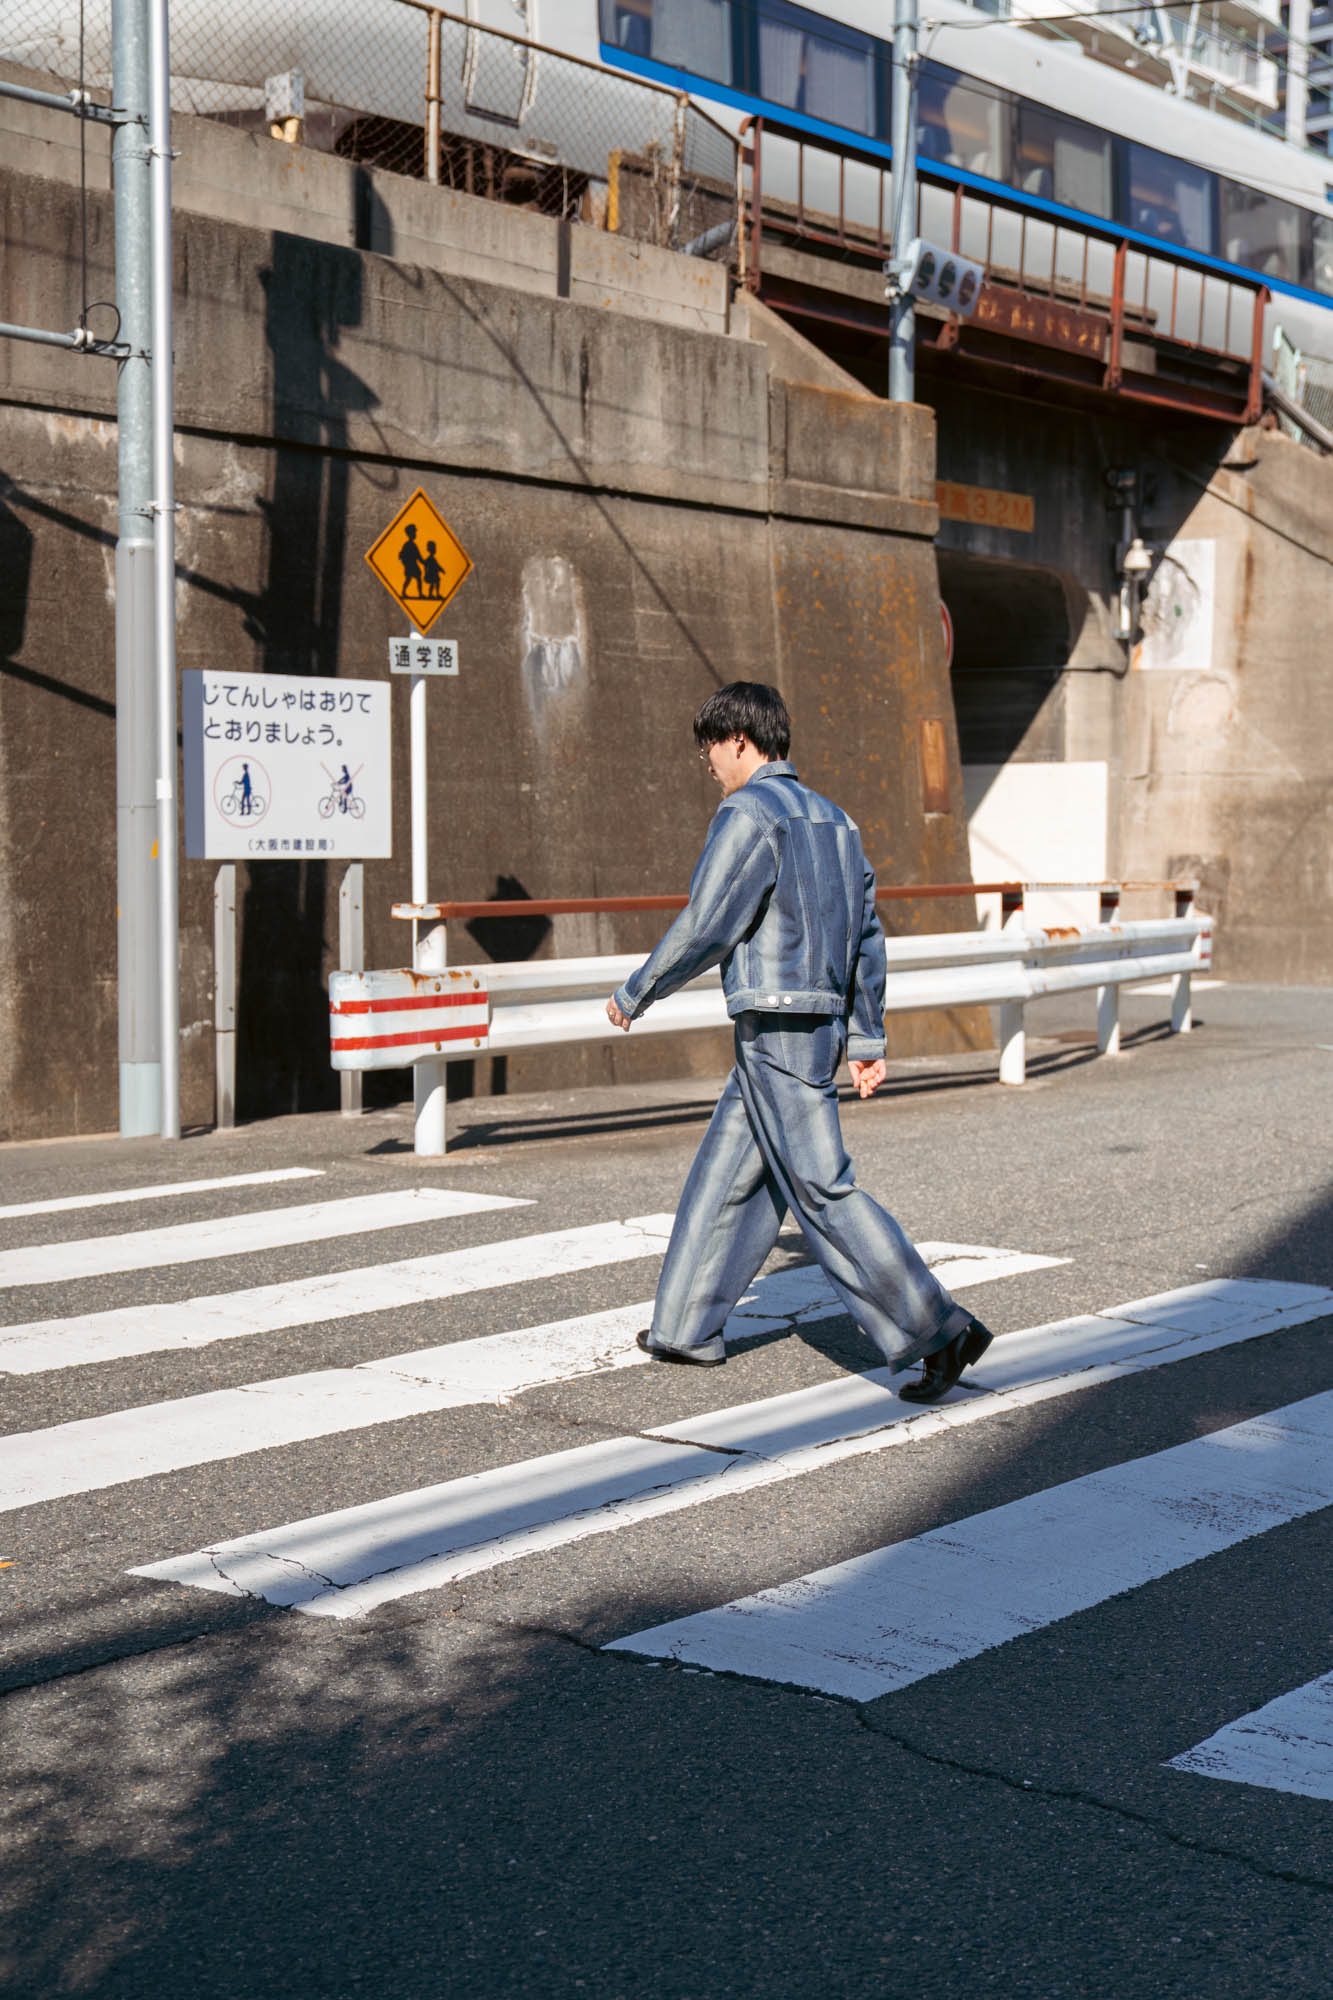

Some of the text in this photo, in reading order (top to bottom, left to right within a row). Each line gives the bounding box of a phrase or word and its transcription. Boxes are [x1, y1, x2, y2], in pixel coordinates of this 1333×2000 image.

[394, 645, 453, 669] 通学路
[202, 683, 373, 714] じてんしゃはおりて
[204, 717, 343, 746] とおりましょう。
